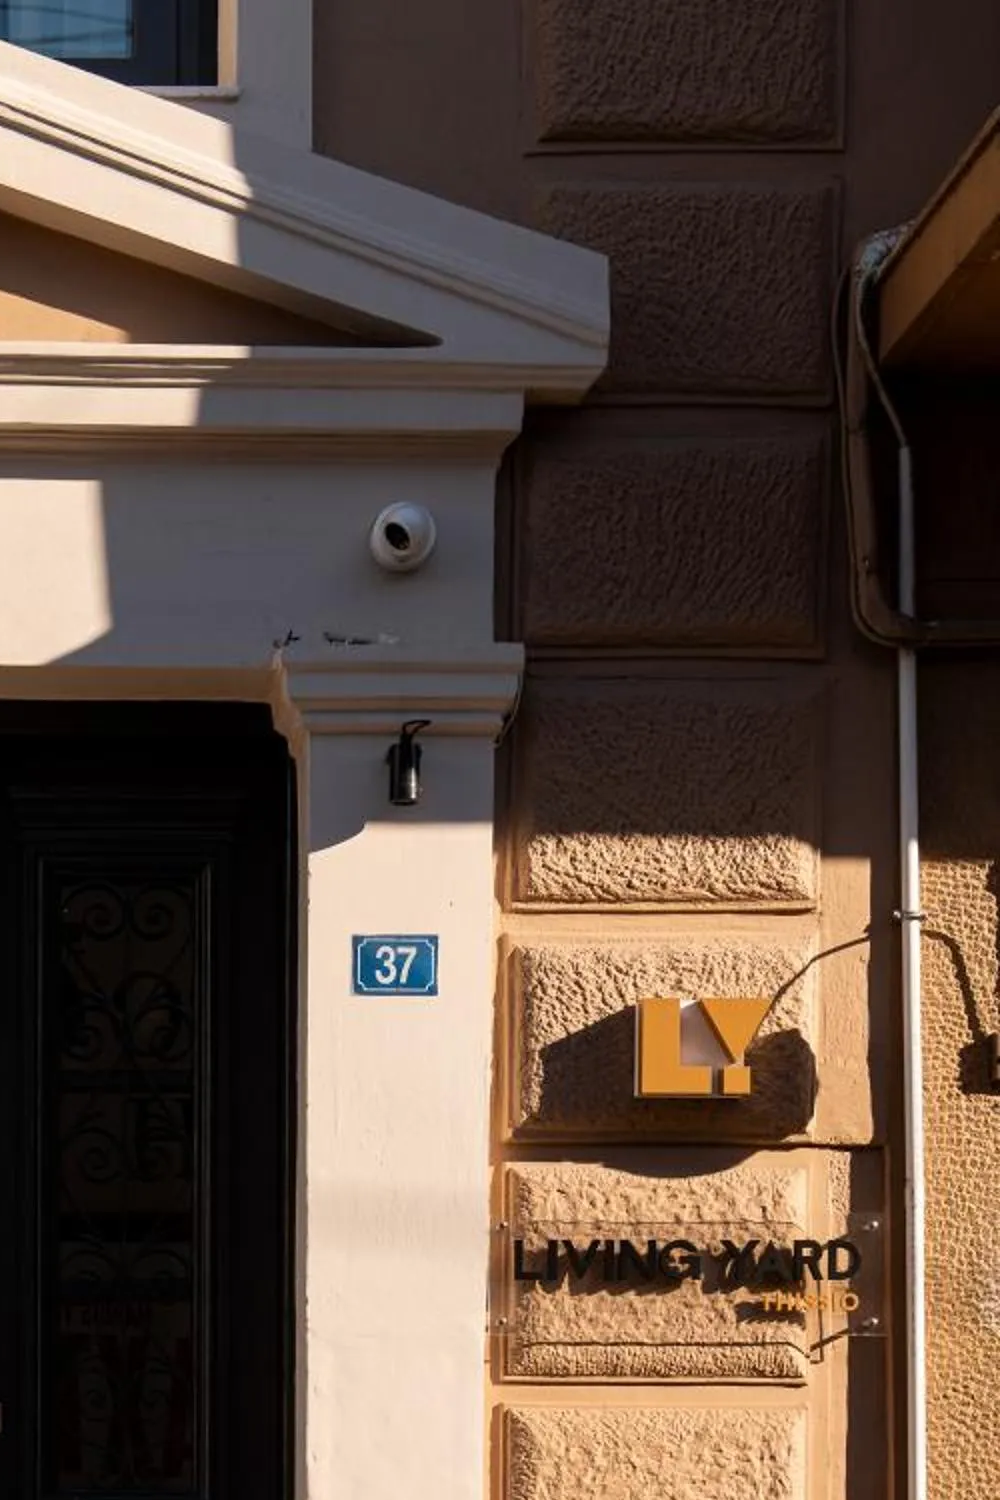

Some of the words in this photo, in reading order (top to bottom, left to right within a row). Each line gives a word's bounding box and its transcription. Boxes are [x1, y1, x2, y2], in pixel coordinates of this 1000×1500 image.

[375, 945, 417, 985] 37
[514, 1240, 698, 1282] LIVING
[721, 1240, 861, 1282] YARD
